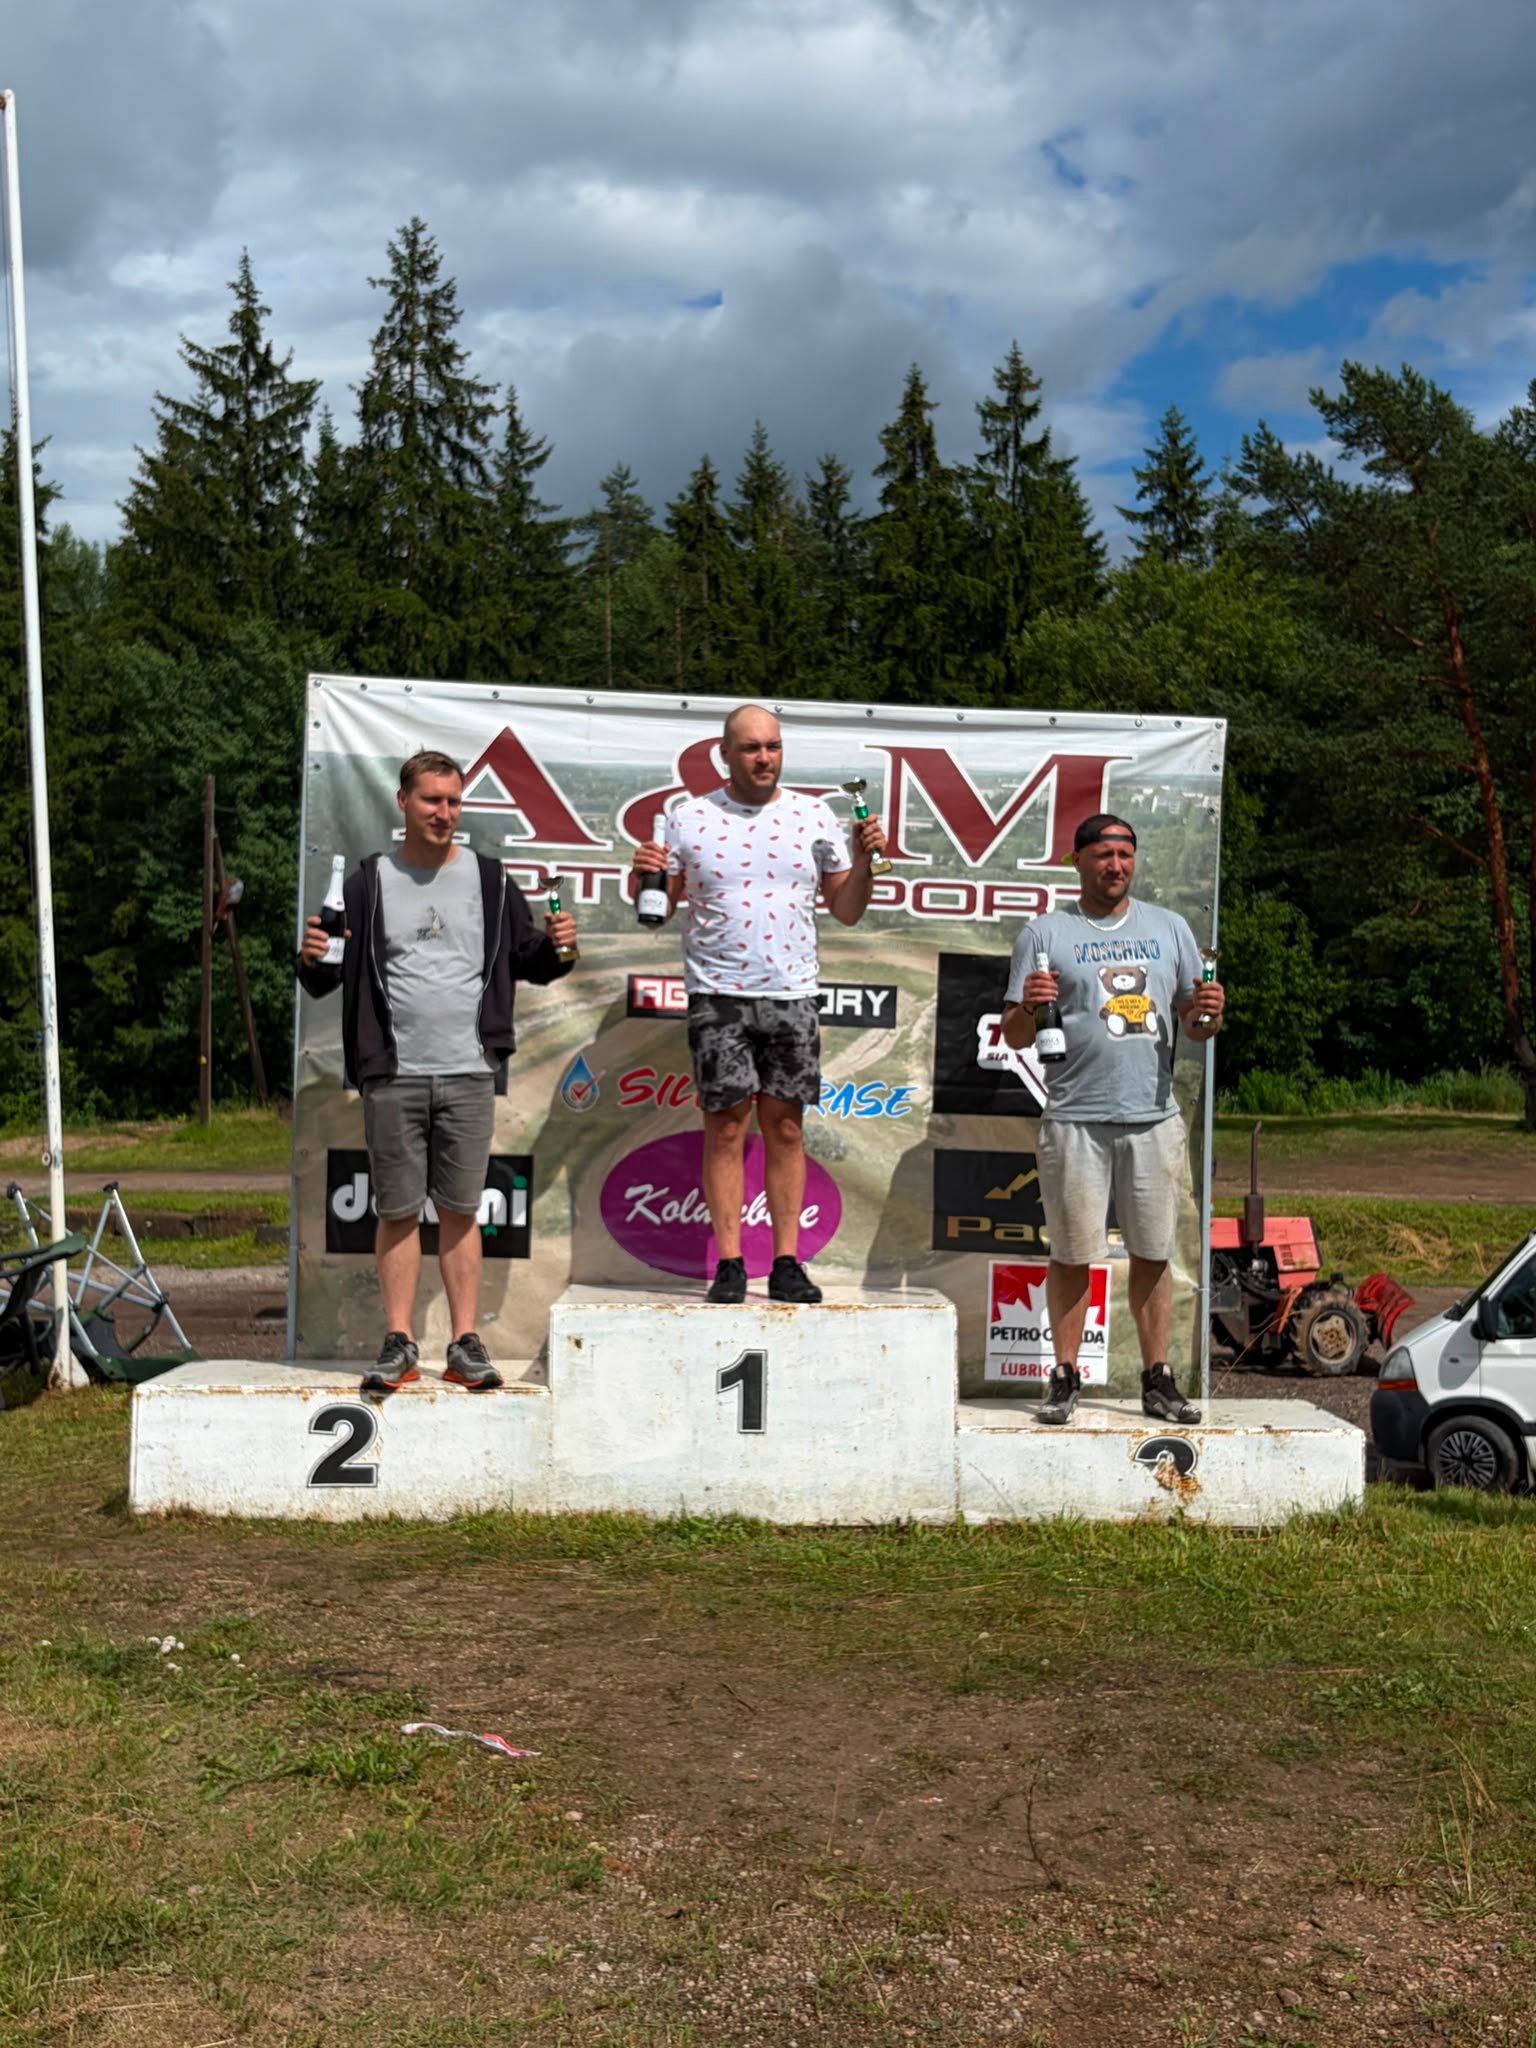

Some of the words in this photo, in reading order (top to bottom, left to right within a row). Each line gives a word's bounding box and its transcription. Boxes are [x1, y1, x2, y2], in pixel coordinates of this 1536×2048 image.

[1073, 938, 1160, 964] MOSCHINO
[987, 1052, 1009, 1061] SIA
[990, 1326, 1105, 1344] PETRO-CDA
[1000, 1361, 1092, 1380] LUBRICS
[717, 1348, 768, 1433] 1
[307, 1402, 379, 1488] 2
